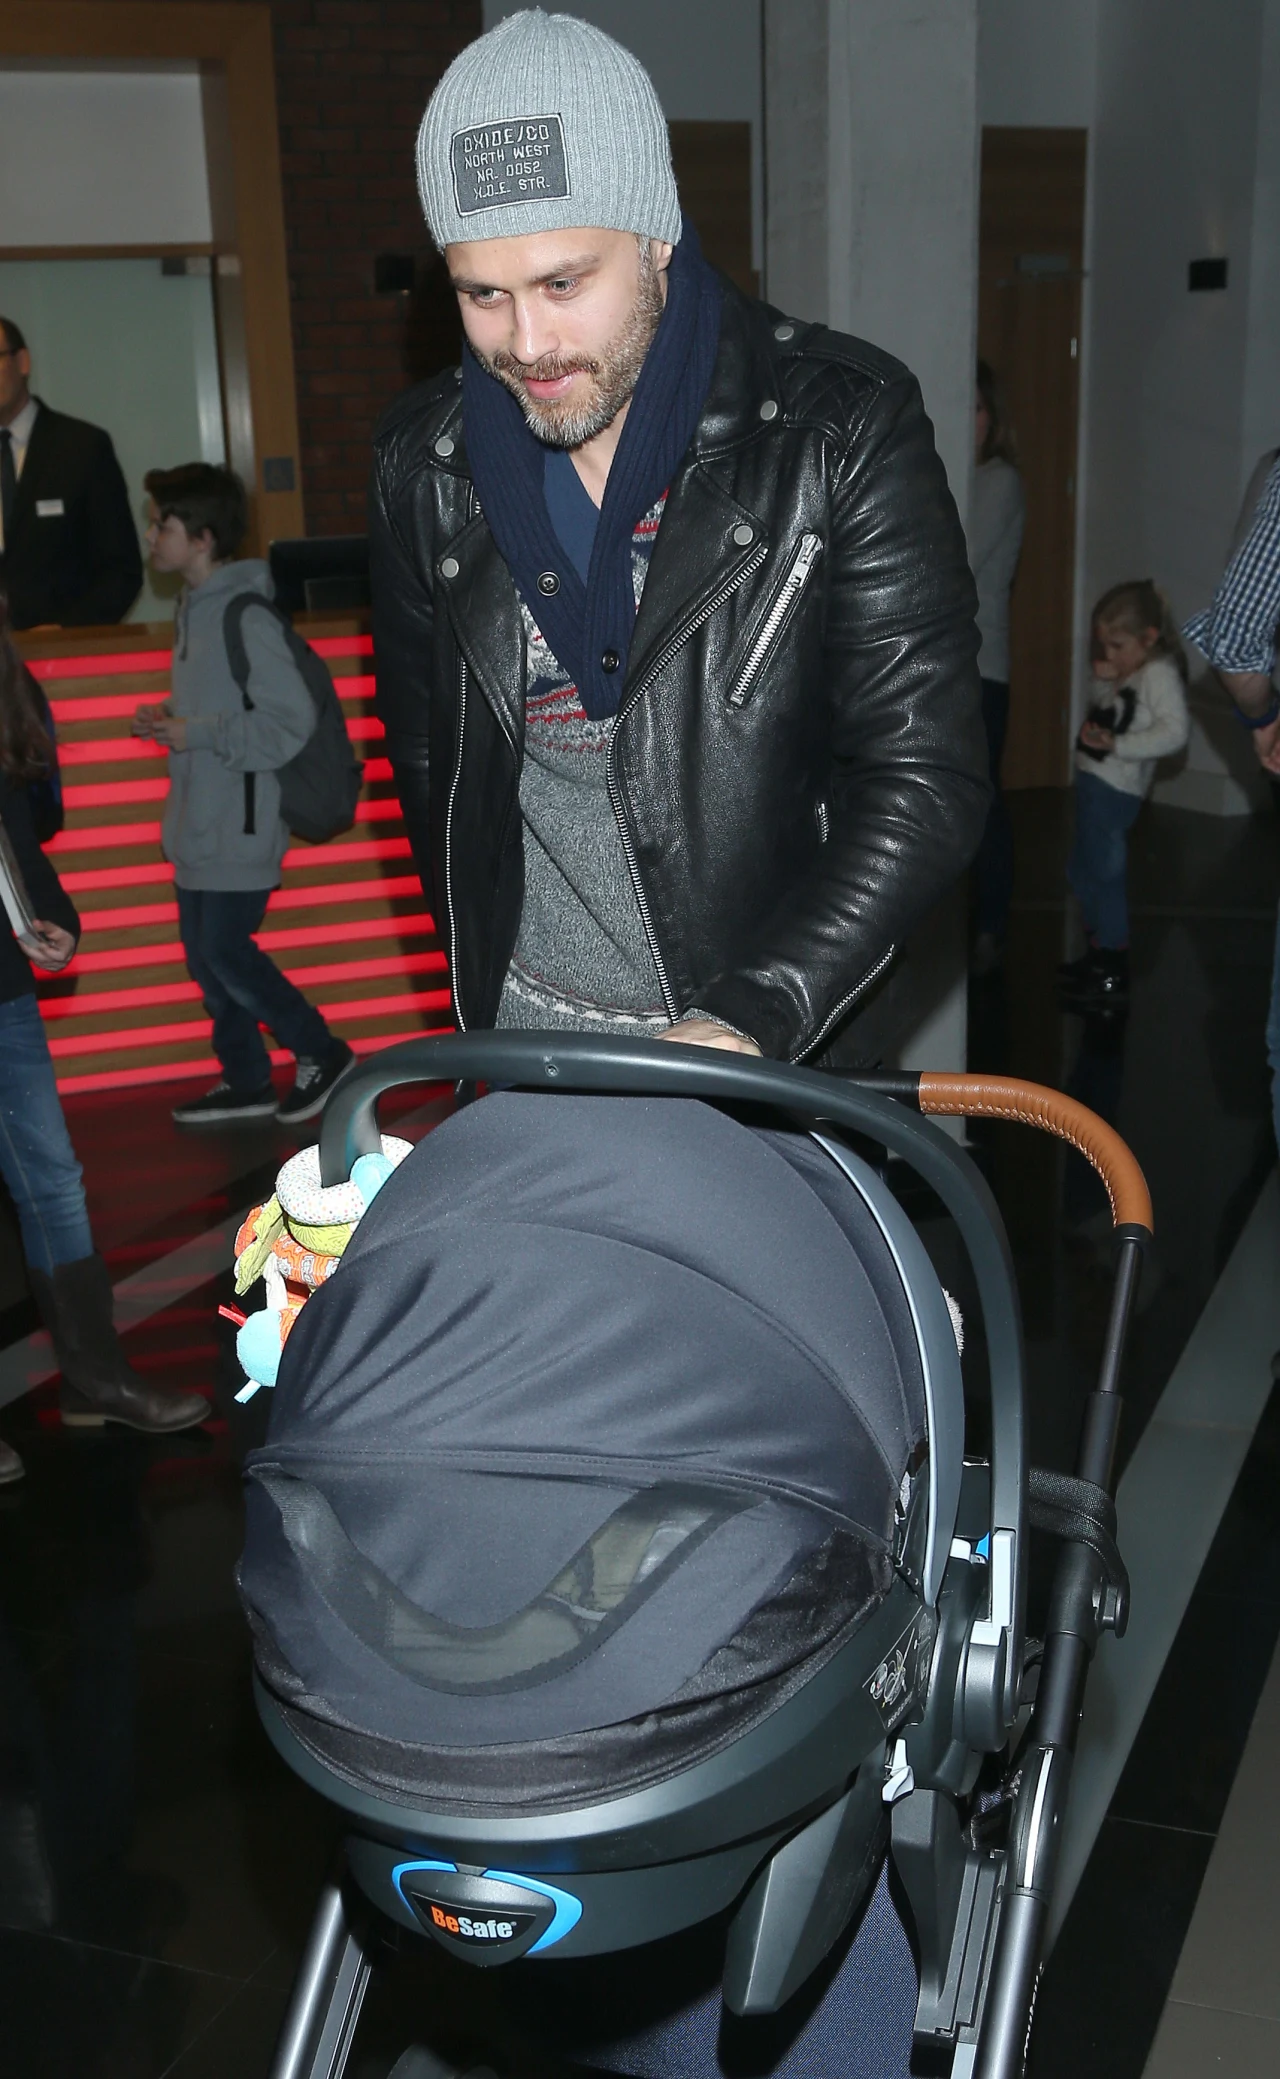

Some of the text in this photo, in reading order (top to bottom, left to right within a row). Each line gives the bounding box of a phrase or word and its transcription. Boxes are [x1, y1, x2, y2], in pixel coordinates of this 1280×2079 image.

[464, 124, 549, 153] OXIDE/CO
[465, 144, 551, 170] NORTH WEST
[477, 160, 542, 184] NR. 0052
[518, 176, 551, 191] STR.
